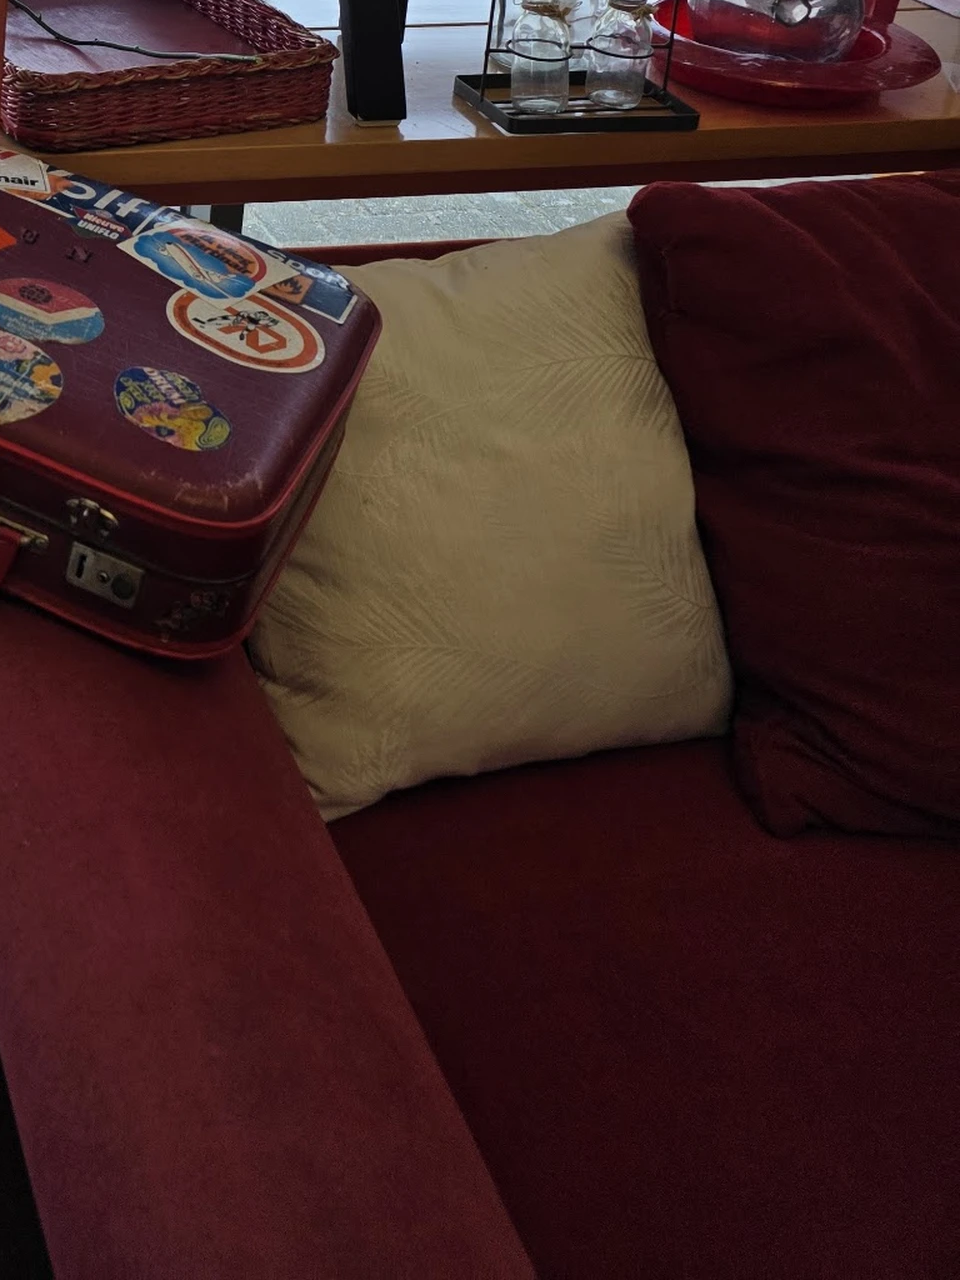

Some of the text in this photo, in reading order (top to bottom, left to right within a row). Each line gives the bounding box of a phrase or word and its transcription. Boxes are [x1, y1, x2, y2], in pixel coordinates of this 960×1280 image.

[54, 172, 151, 218] olf
[77, 220, 120, 240] UNIFLO
[83, 212, 125, 233] Nieuwe
